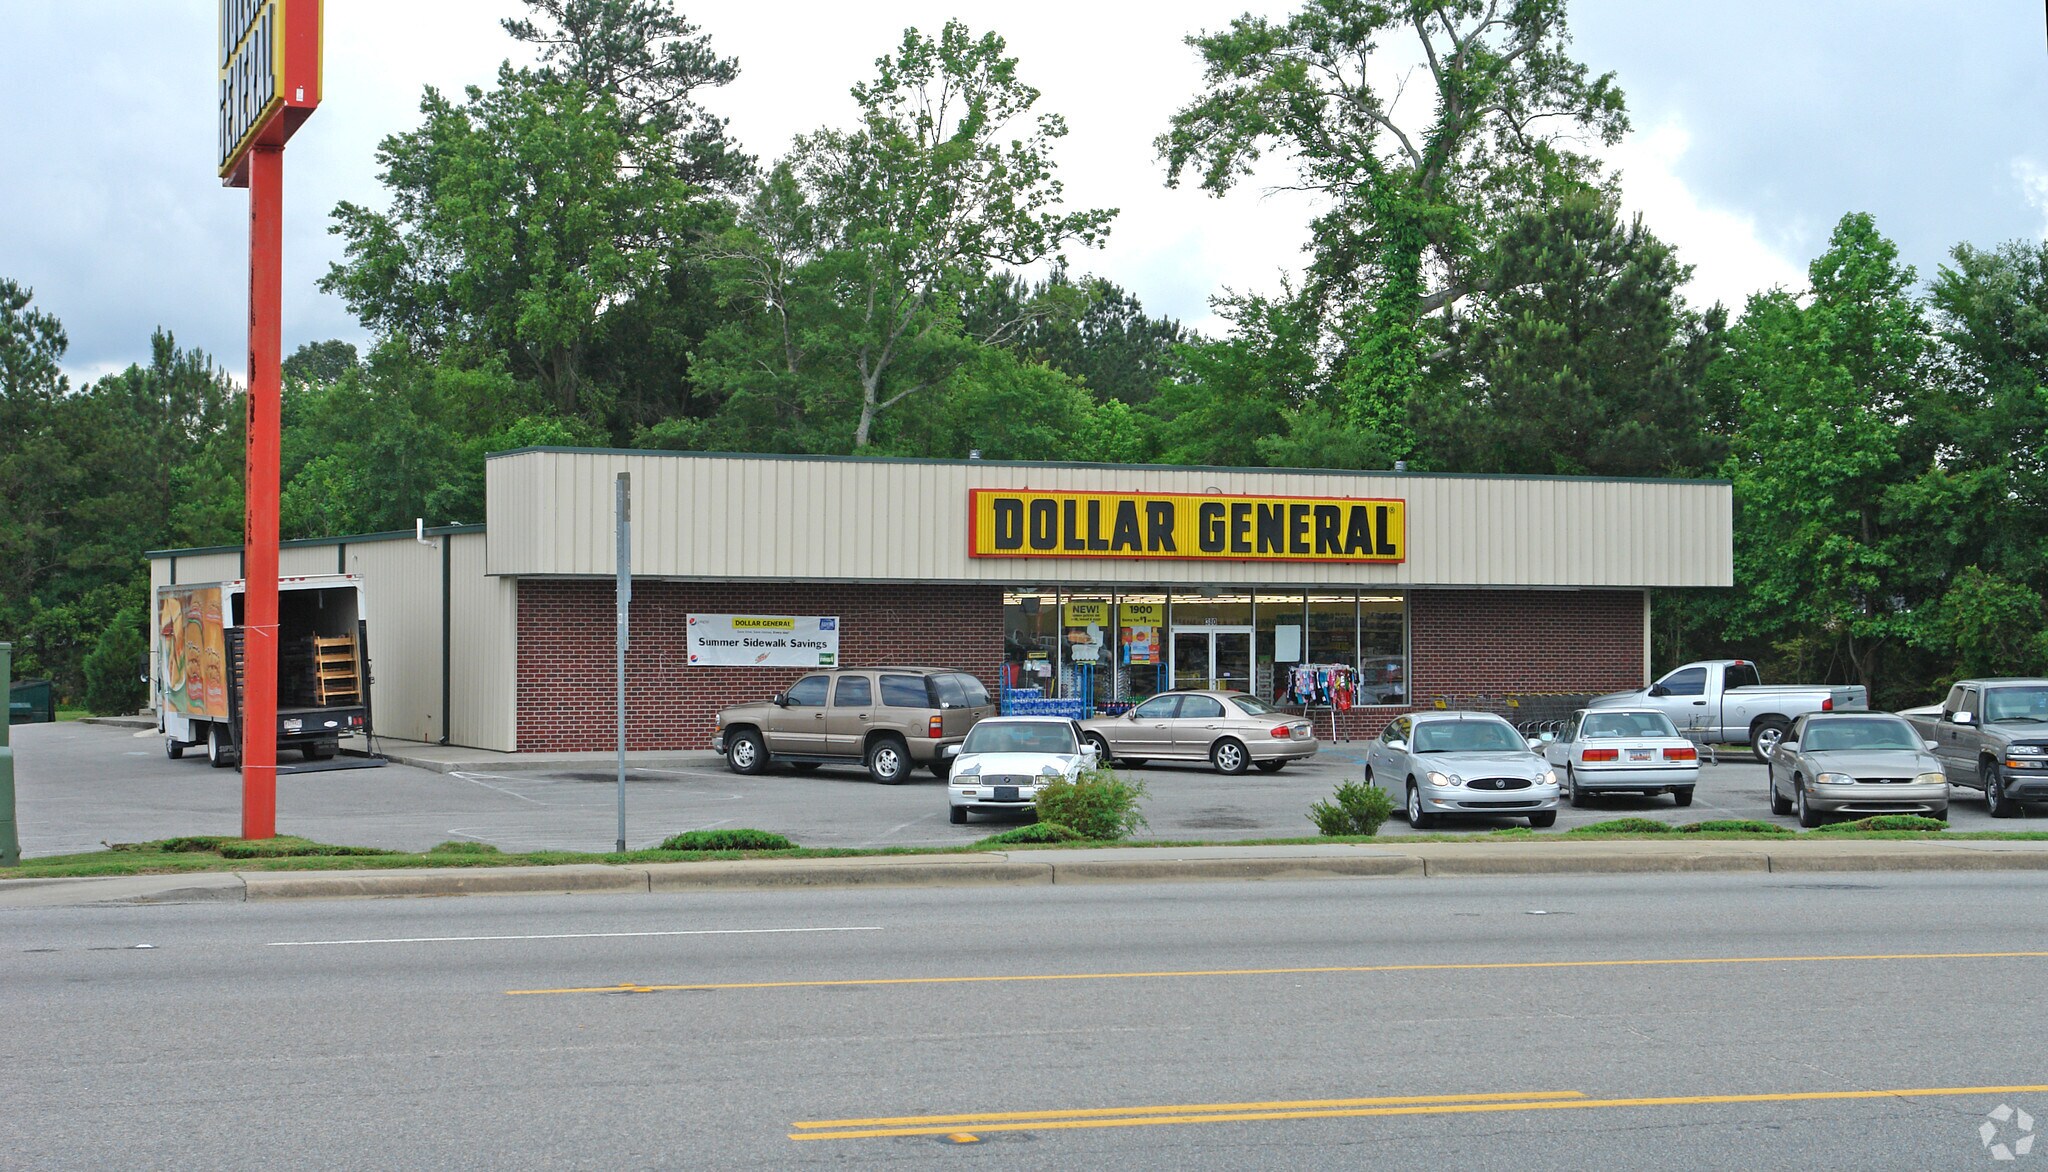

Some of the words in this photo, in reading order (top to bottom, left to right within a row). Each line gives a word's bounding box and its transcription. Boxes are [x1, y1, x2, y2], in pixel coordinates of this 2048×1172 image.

[219, 3, 275, 167] GENERAL
[993, 497, 1177, 552] DOLLAR
[1199, 501, 1397, 556] GENERAL
[1072, 605, 1100, 614] NEW!
[1129, 605, 1153, 614] 1900
[735, 619, 761, 627] DOLLAR
[762, 620, 791, 628] GENERAL
[698, 637, 740, 648] Summer
[743, 637, 787, 648] Sidewalk
[790, 639, 828, 650] Savings
